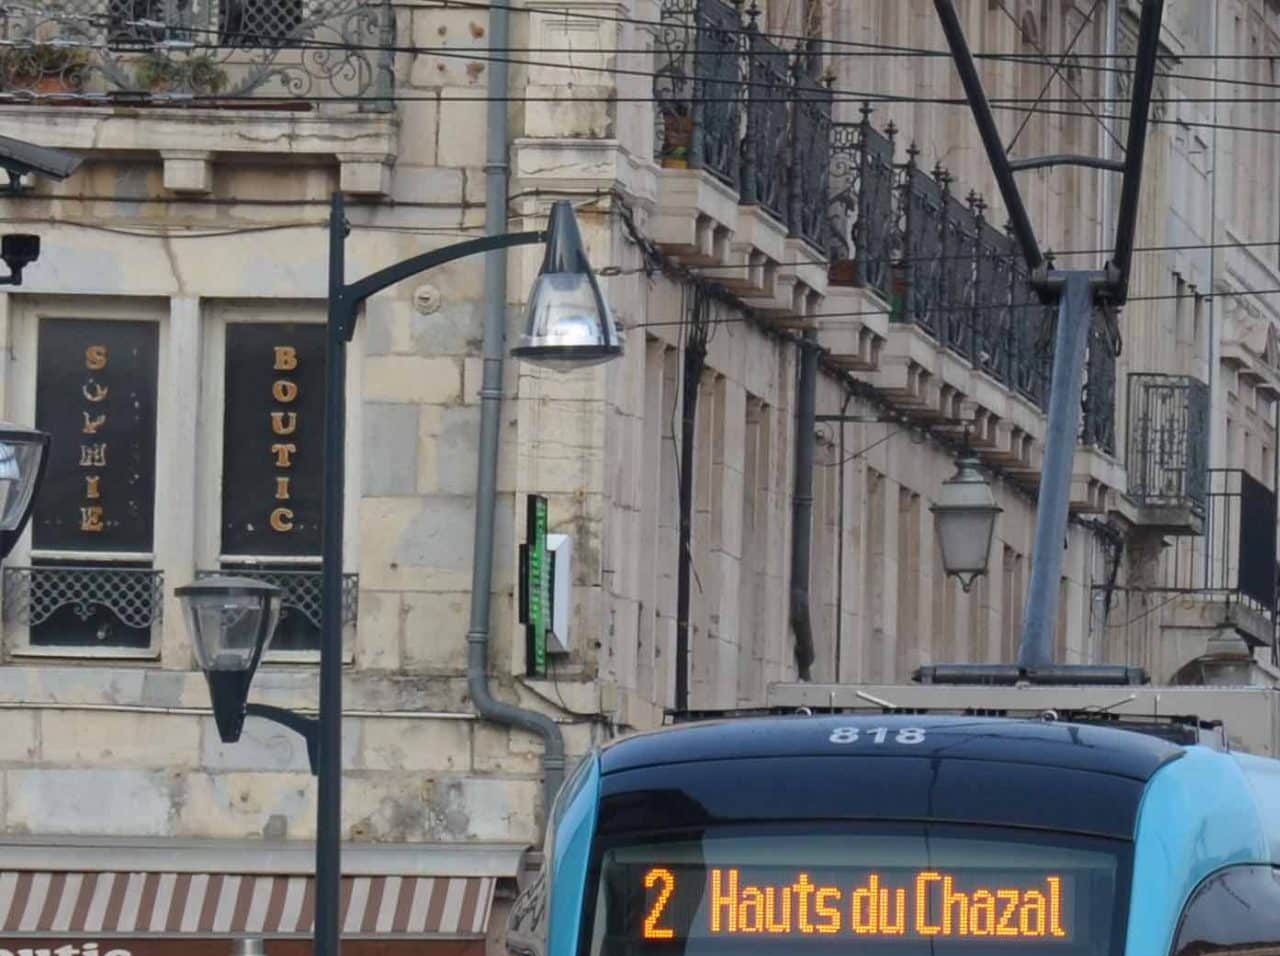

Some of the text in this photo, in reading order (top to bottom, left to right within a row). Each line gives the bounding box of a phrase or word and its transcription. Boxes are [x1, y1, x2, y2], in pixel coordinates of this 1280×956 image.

[270, 346, 298, 532] BOUTIC
[829, 727, 926, 744] 818
[644, 868, 1065, 938] 2 Hauts du Chazal
